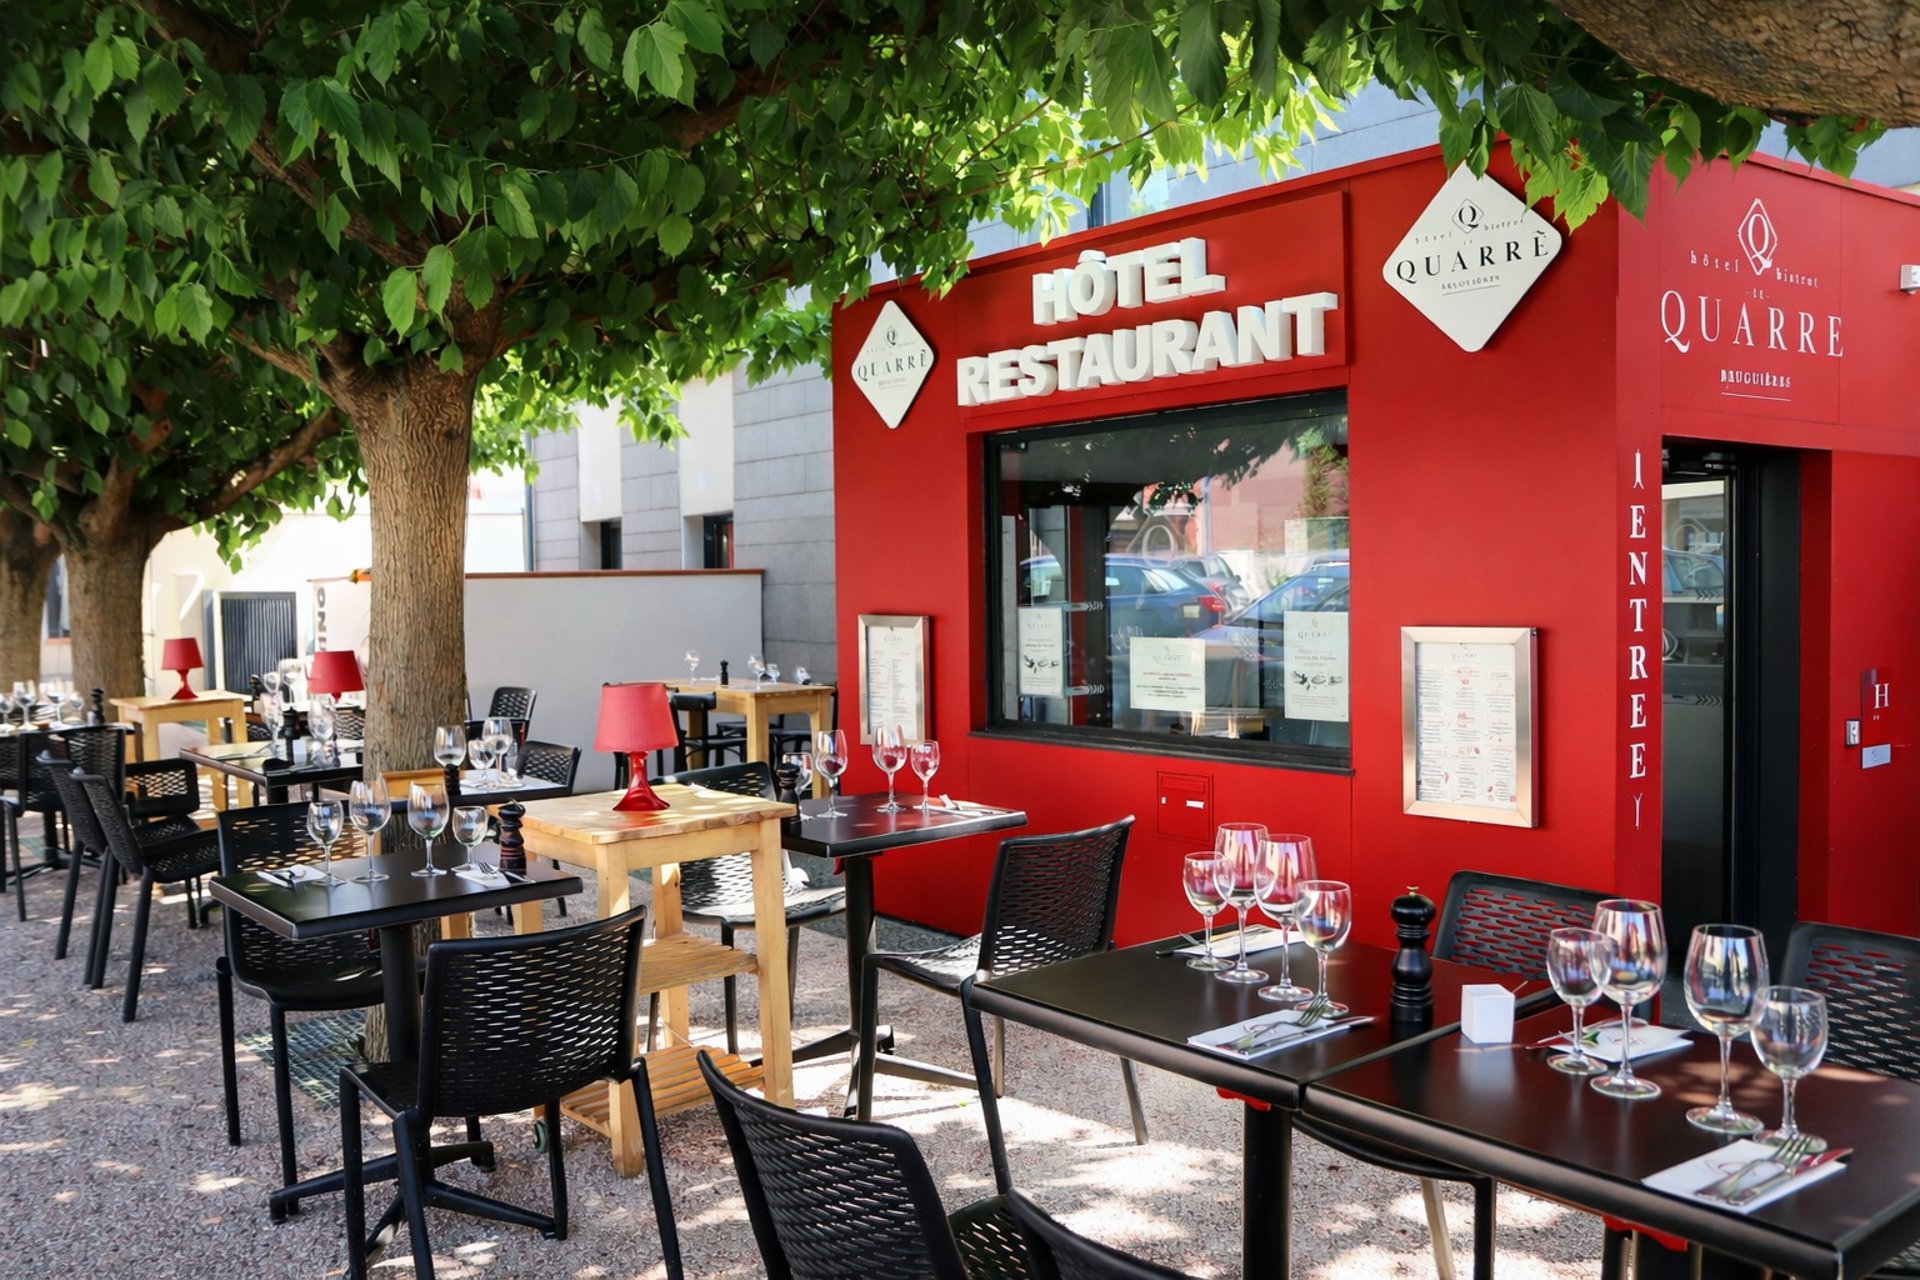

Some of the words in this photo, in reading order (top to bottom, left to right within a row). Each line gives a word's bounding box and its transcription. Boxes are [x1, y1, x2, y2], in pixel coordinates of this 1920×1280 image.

[1032, 237, 1226, 325] HÔTEL
[1689, 250, 1740, 272] hôtel
[957, 291, 1339, 407] RESTAURANT
[1873, 683, 1890, 710] H
